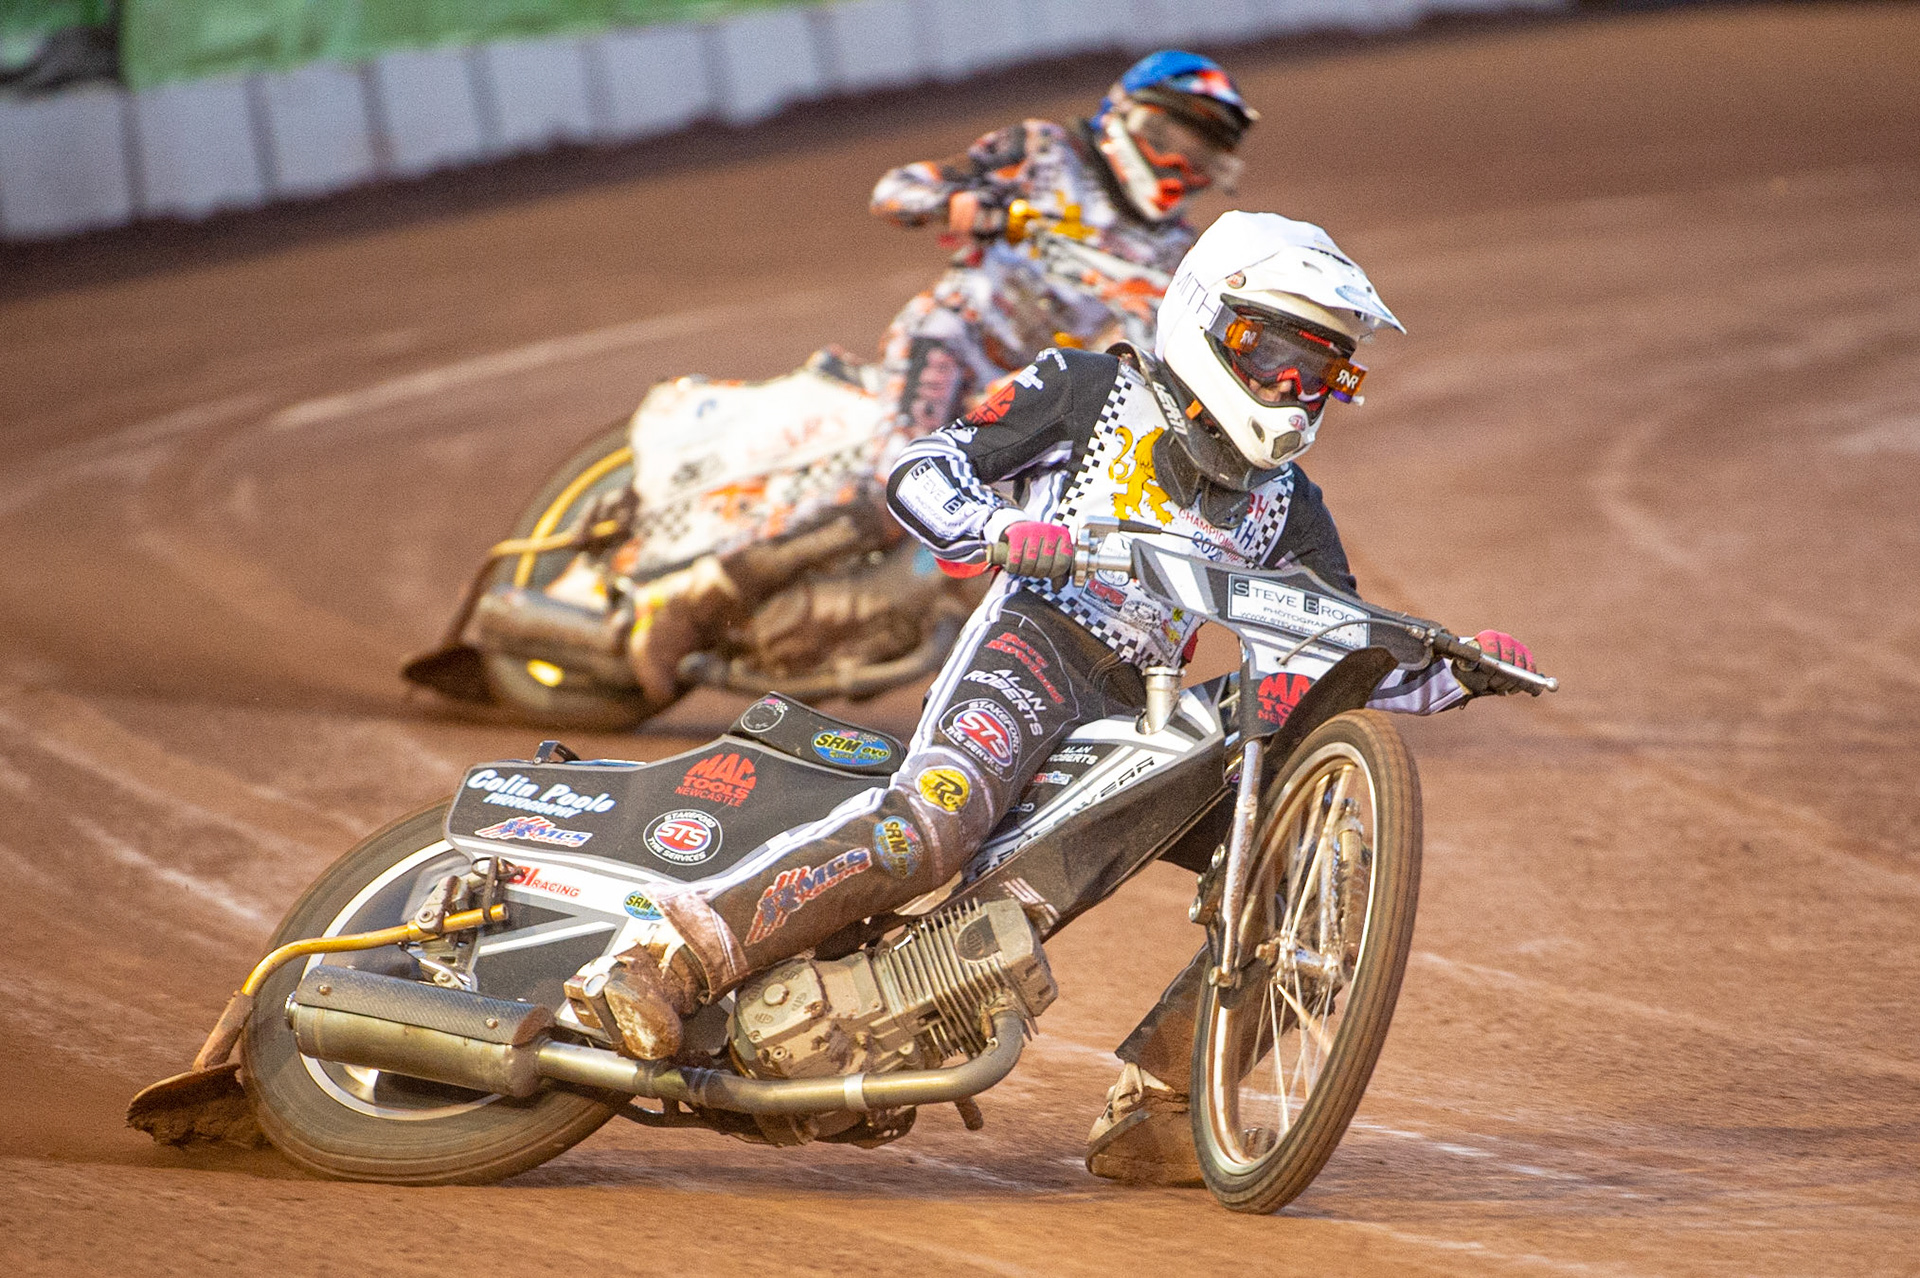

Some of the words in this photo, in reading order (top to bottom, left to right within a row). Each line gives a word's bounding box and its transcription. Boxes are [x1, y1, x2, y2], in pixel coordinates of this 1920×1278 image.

[1234, 580, 1297, 608] STEVE
[1263, 606, 1340, 632] PHOTOGRAP
[963, 670, 1044, 736] ROBERTS
[993, 669, 1046, 712] ALAN
[1258, 673, 1311, 707] MA
[955, 711, 1008, 758] STS
[969, 701, 1019, 754] STAKEFORD
[814, 733, 864, 753] SRM
[686, 753, 757, 790] MAC
[467, 769, 539, 797] Colin
[539, 784, 617, 813] Poole
[674, 786, 744, 807] NEWCASTLE
[683, 776, 750, 800] TOOLS
[483, 792, 582, 818] PHOTOGRAPHY
[664, 812, 717, 828] STAKEFORD
[655, 822, 709, 847] STS
[662, 851, 706, 862] SERVICES
[531, 879, 580, 897] RACING
[626, 895, 652, 910] SRM
